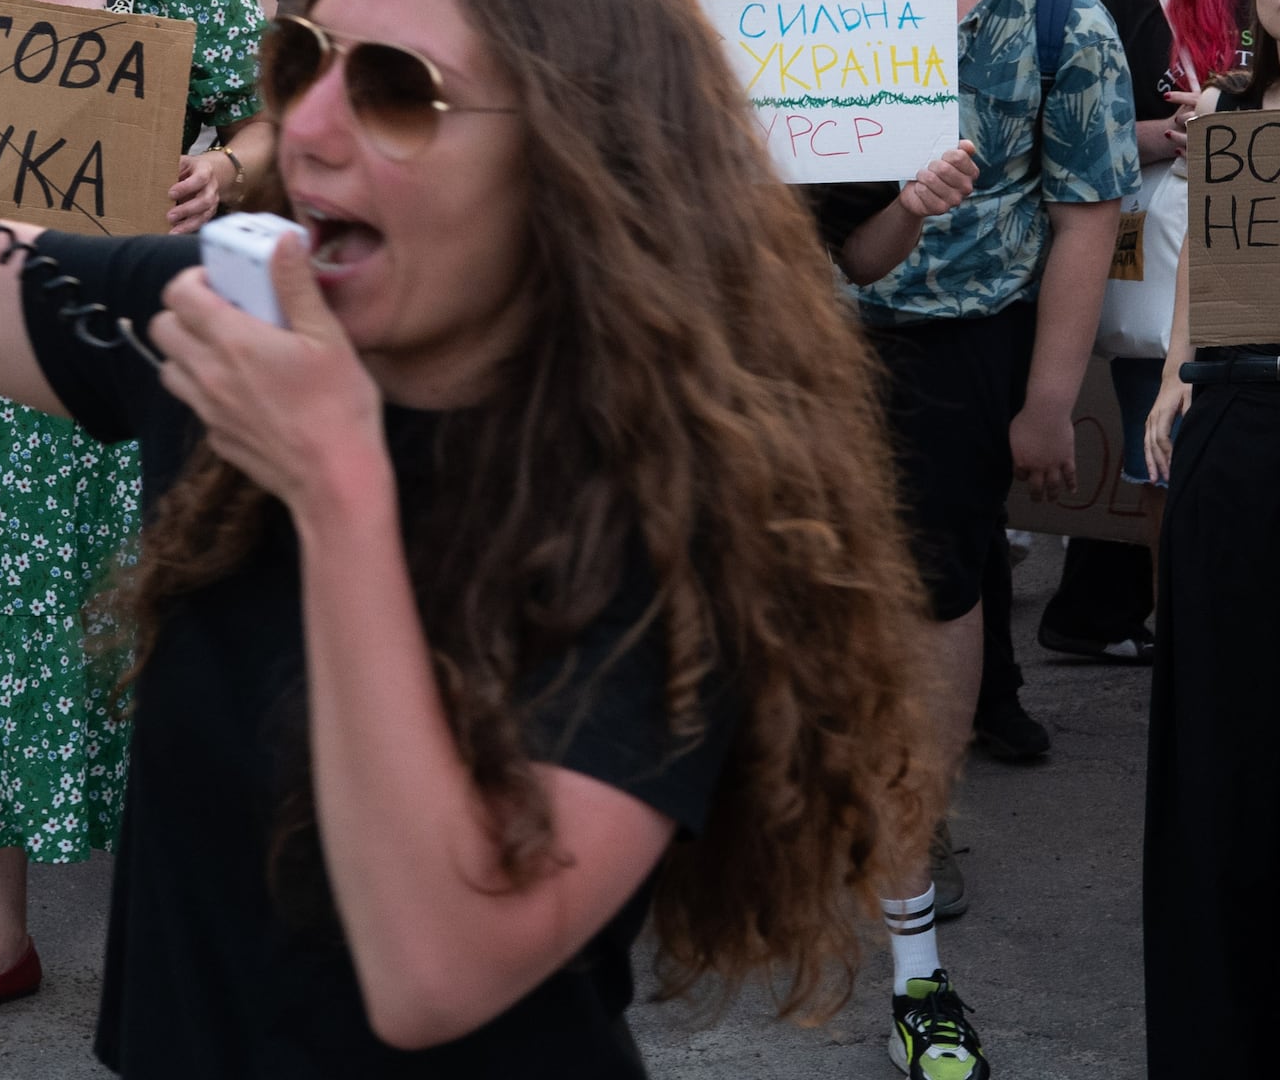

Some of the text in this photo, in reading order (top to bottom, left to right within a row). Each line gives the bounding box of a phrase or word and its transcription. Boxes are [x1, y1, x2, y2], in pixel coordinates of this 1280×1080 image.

[739, 0, 924, 39] СИЛЬНА
[739, 41, 949, 93] УКРАЇНА
[1204, 193, 1277, 251] НЕ
